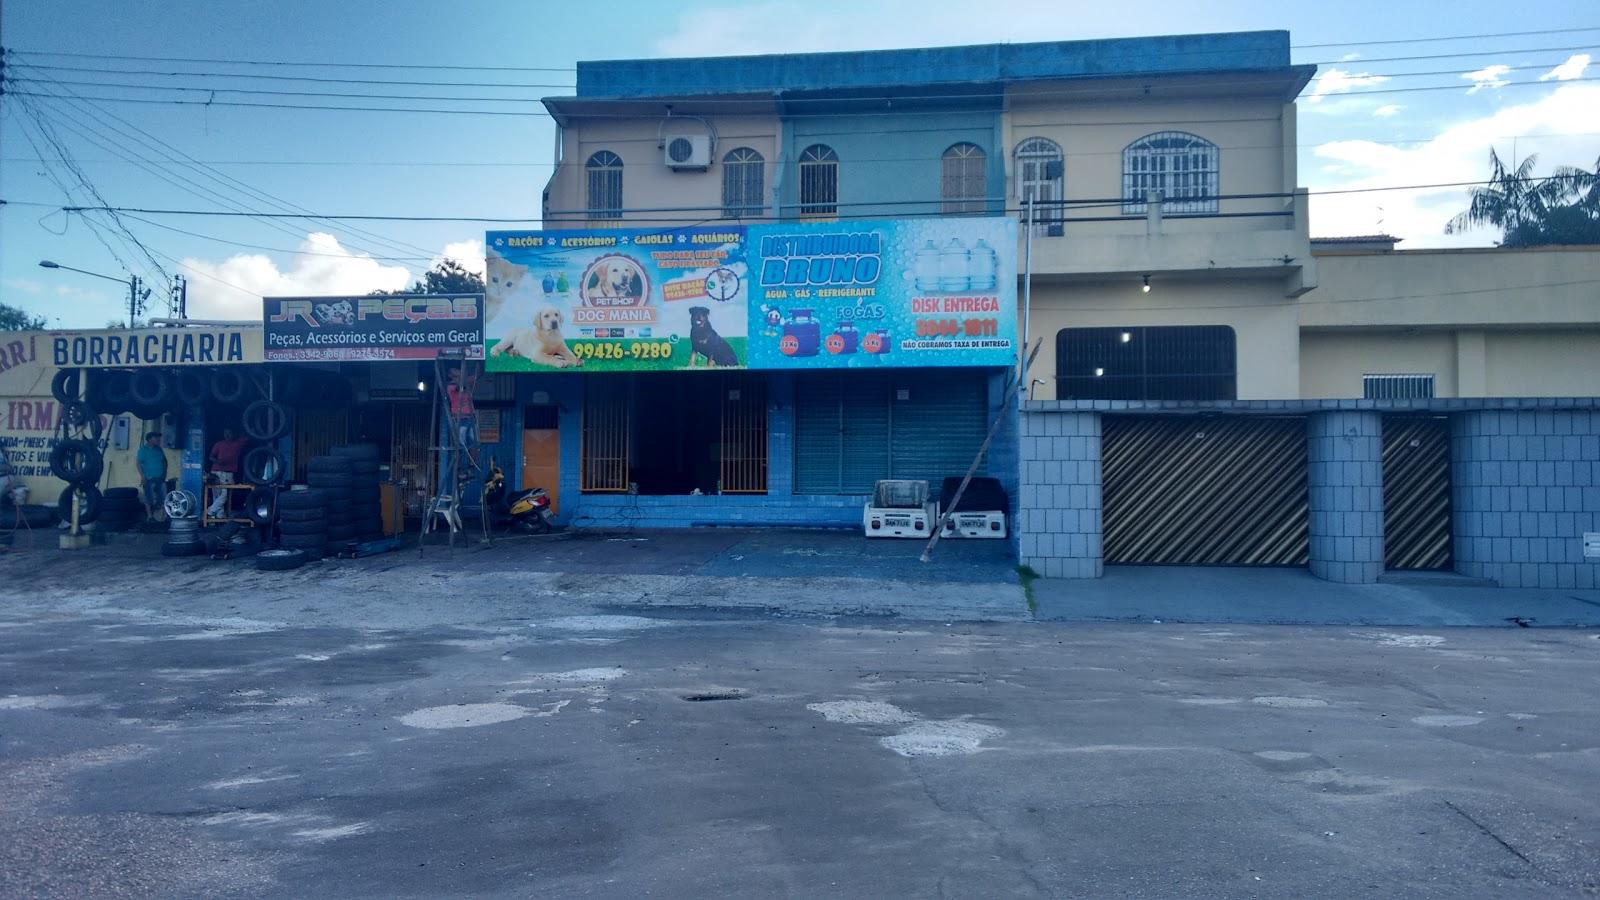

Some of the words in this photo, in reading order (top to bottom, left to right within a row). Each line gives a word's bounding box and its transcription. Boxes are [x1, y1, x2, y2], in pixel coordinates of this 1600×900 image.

[508, 236, 544, 247] RAÇÕES
[561, 235, 616, 247] ACESSÓRIOS
[634, 234, 673, 245] GAIOLAS
[691, 232, 739, 244] AQUÁRIOS
[761, 232, 880, 257] DISTRIBUIDORA
[761, 256, 881, 285] BRUNO
[613, 297, 634, 305] SHOP
[765, 290, 788, 298] AGUA
[818, 288, 875, 297] REFRIGERANTE
[270, 300, 320, 327] JR
[912, 298, 940, 313] DISK
[944, 297, 1000, 312] ENTREGA
[577, 310, 606, 321] DOG
[609, 309, 652, 321] MANIA
[269, 332, 303, 347] Peças,
[306, 331, 366, 344] Acessórios
[369, 334, 376, 343] e
[379, 330, 425, 347] Serviços
[427, 333, 445, 343] em
[448, 330, 479, 343] Geral
[53, 332, 243, 366] BORRACHARIA
[574, 342, 672, 360] 99426-9280
